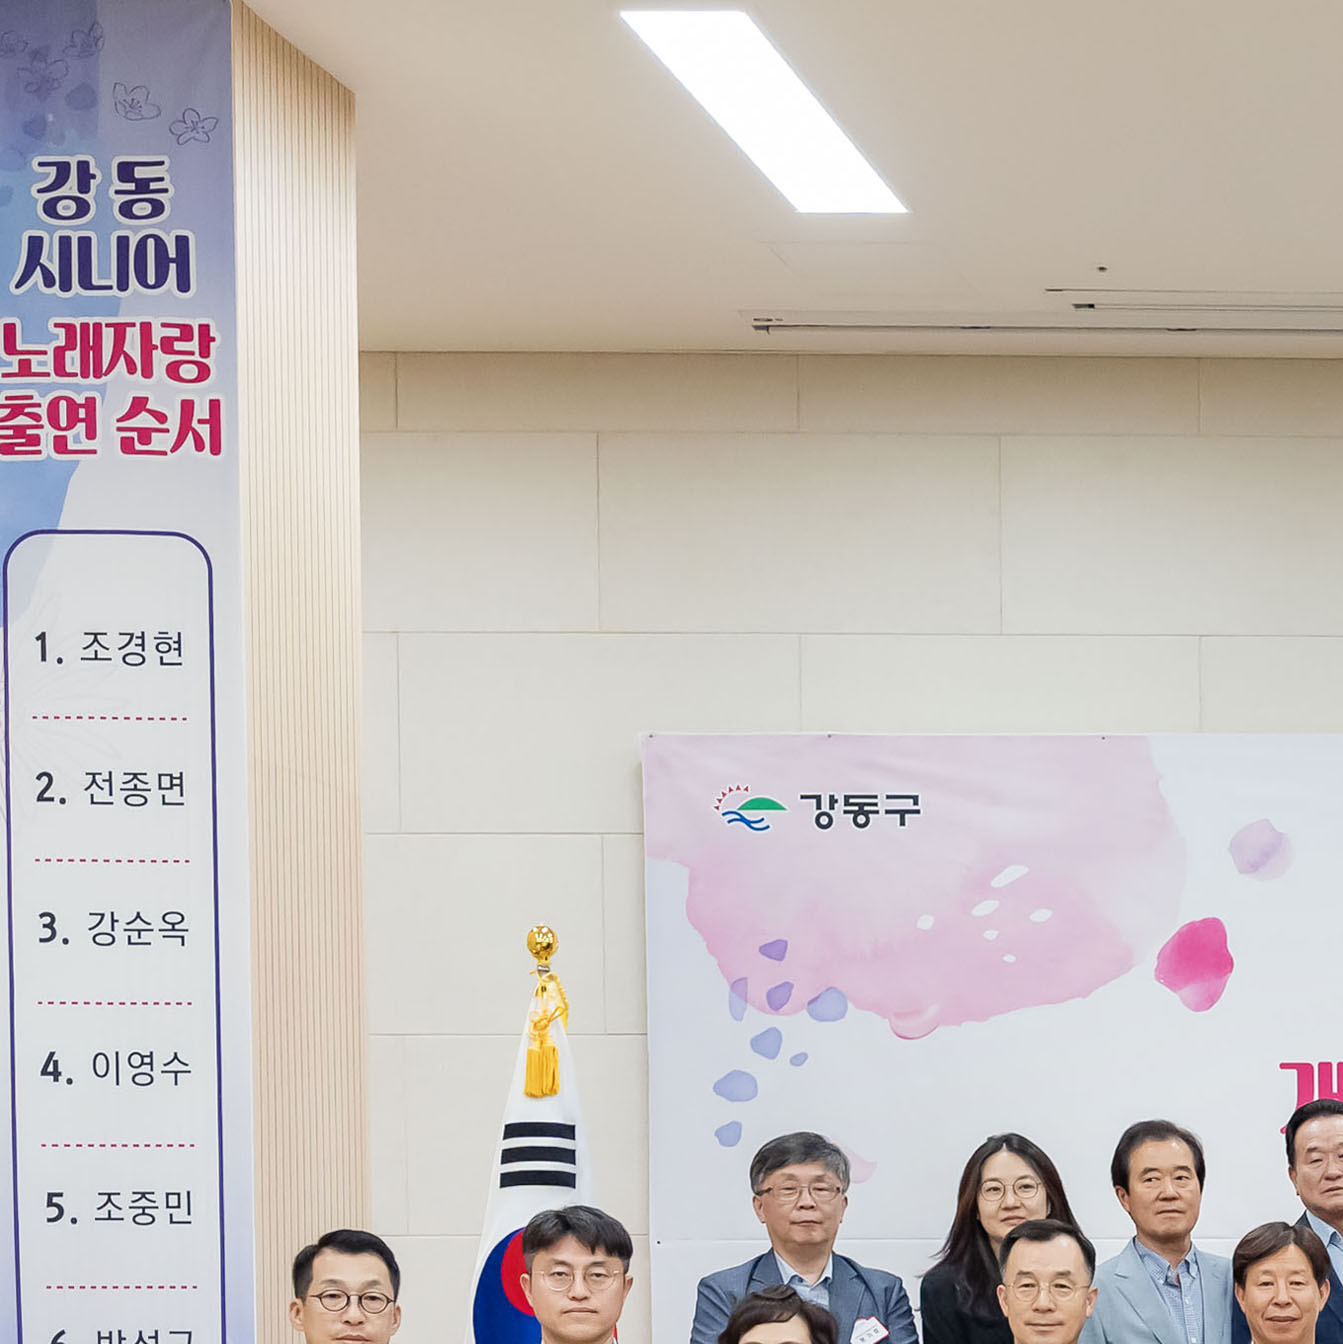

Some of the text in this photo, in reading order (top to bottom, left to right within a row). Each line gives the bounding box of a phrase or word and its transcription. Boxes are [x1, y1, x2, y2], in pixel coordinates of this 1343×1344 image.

[14, 233, 195, 294] 시니어
[1, 321, 217, 384] 노래자랑
[0, 395, 222, 457] 출연 순서
[35, 631, 184, 667] 1. 조경현
[35, 770, 186, 807] 2. 전종면
[799, 793, 921, 830] 강동구
[38, 910, 190, 947] 3. 강순옥
[40, 1050, 193, 1087] 4. 이영수
[45, 1190, 194, 1227] 5. 조중민
